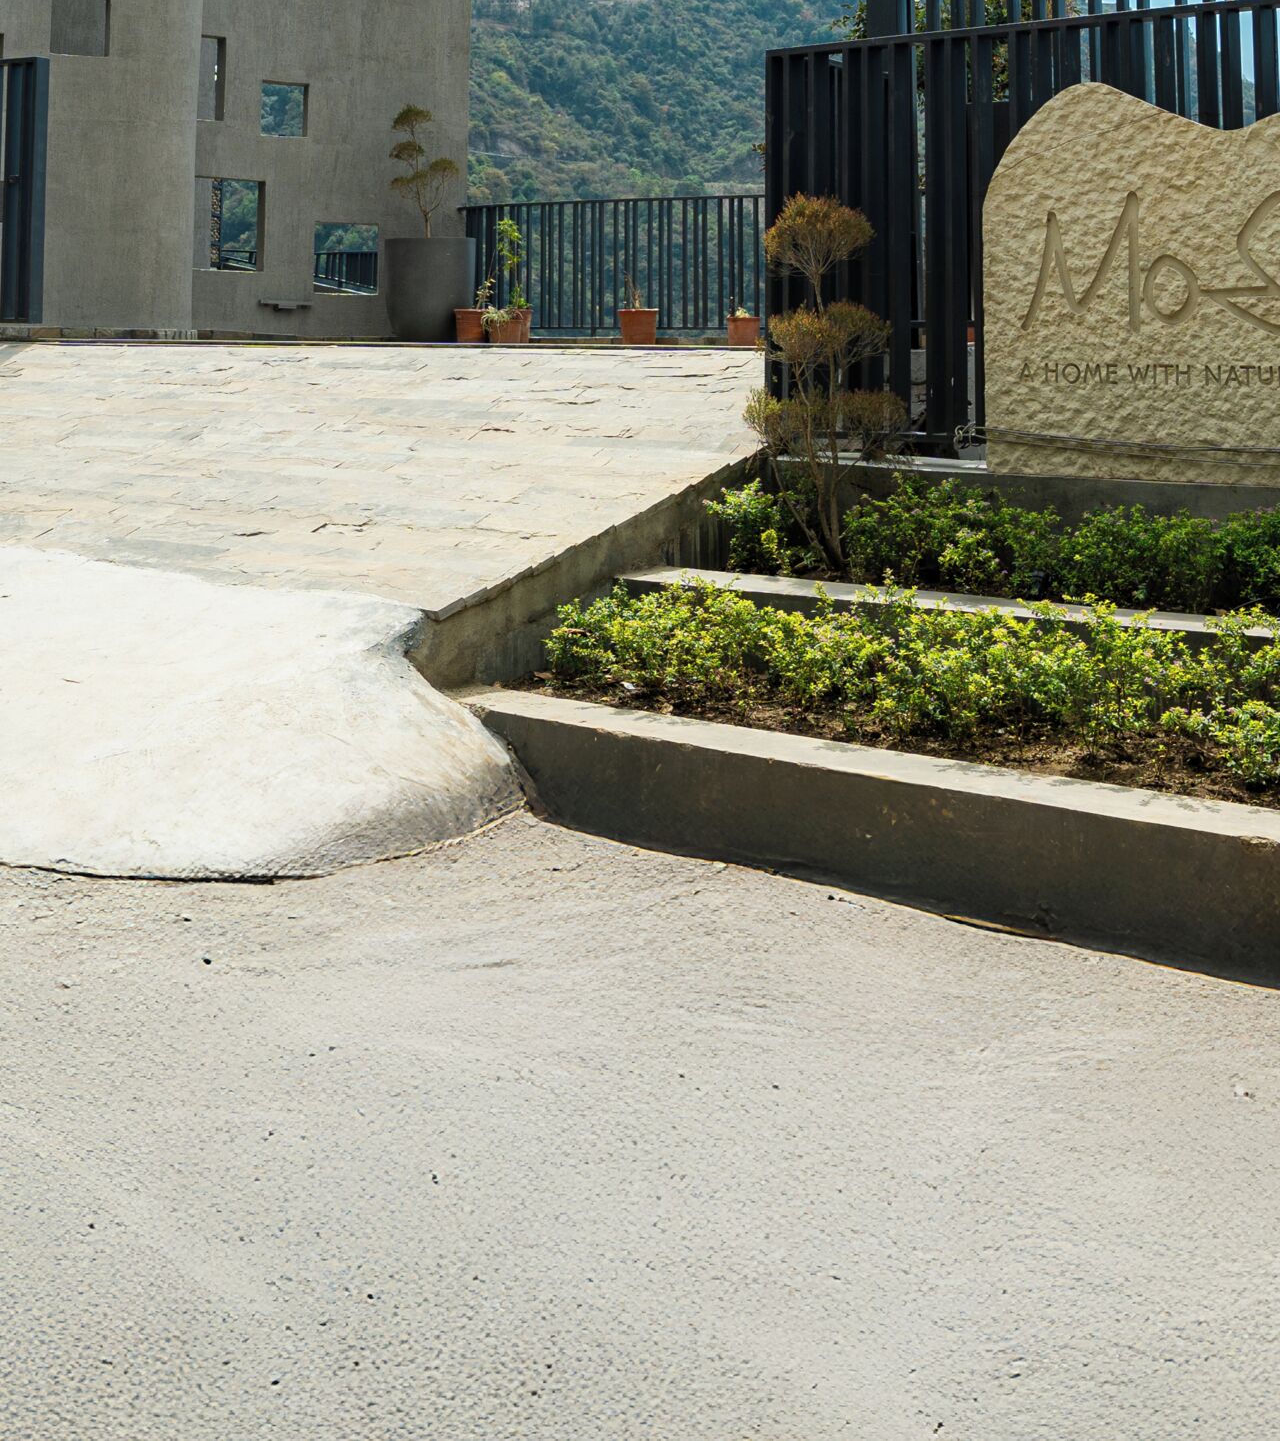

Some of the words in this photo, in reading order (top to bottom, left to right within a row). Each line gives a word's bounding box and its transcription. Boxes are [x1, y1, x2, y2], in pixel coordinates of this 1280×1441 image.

[1020, 362, 1035, 382] A
[1044, 362, 1119, 385] HOME
[1127, 364, 1191, 385] WITH
